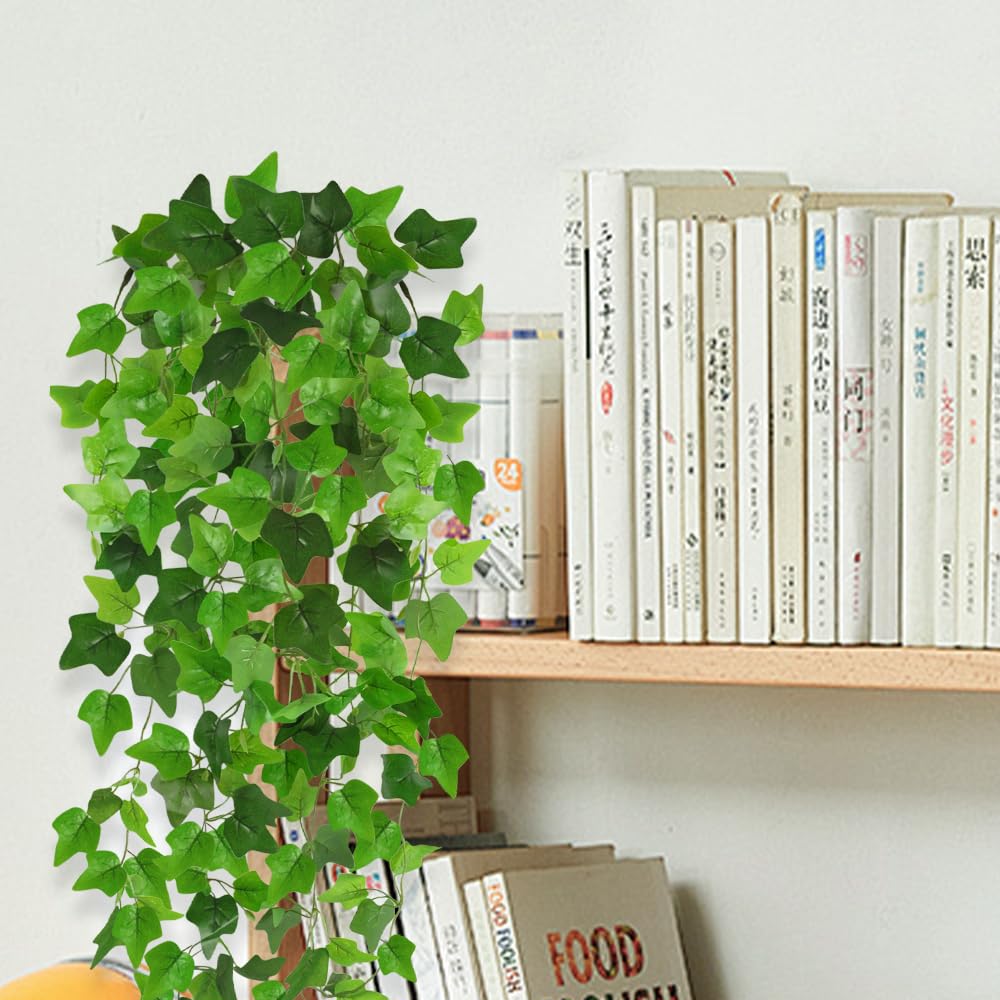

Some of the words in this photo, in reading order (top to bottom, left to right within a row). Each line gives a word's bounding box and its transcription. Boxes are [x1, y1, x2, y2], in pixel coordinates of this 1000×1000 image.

[965, 236, 987, 290] 思索
[496, 462, 519, 482] 24
[546, 923, 645, 987] FOOD
